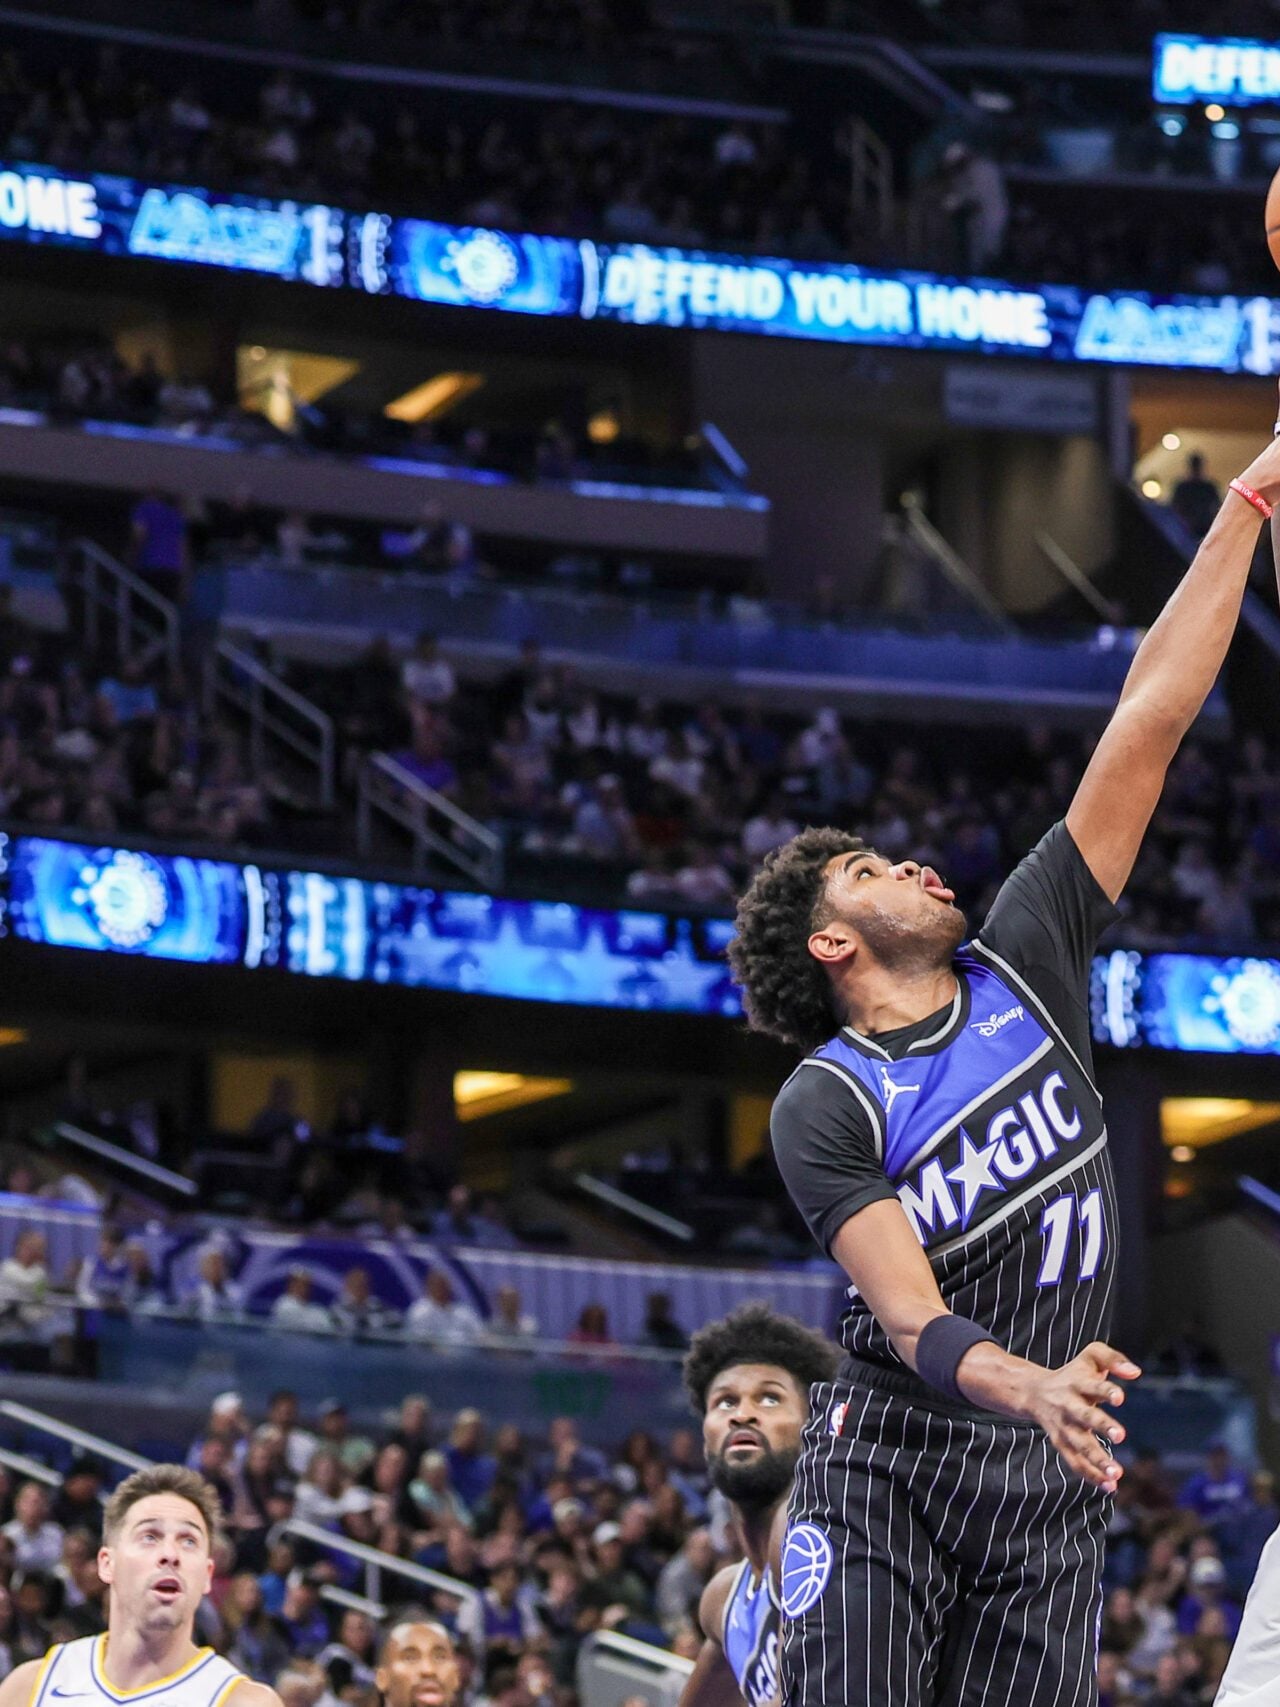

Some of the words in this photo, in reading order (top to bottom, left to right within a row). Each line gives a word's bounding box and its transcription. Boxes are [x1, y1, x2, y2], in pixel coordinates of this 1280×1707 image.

[0, 171, 102, 238] OME
[604, 254, 784, 320] DEFEND
[788, 271, 913, 335] YOUR
[916, 283, 1052, 347] HOME
[898, 1070, 1082, 1246] MAGIC
[1036, 1188, 1101, 1287] 11
